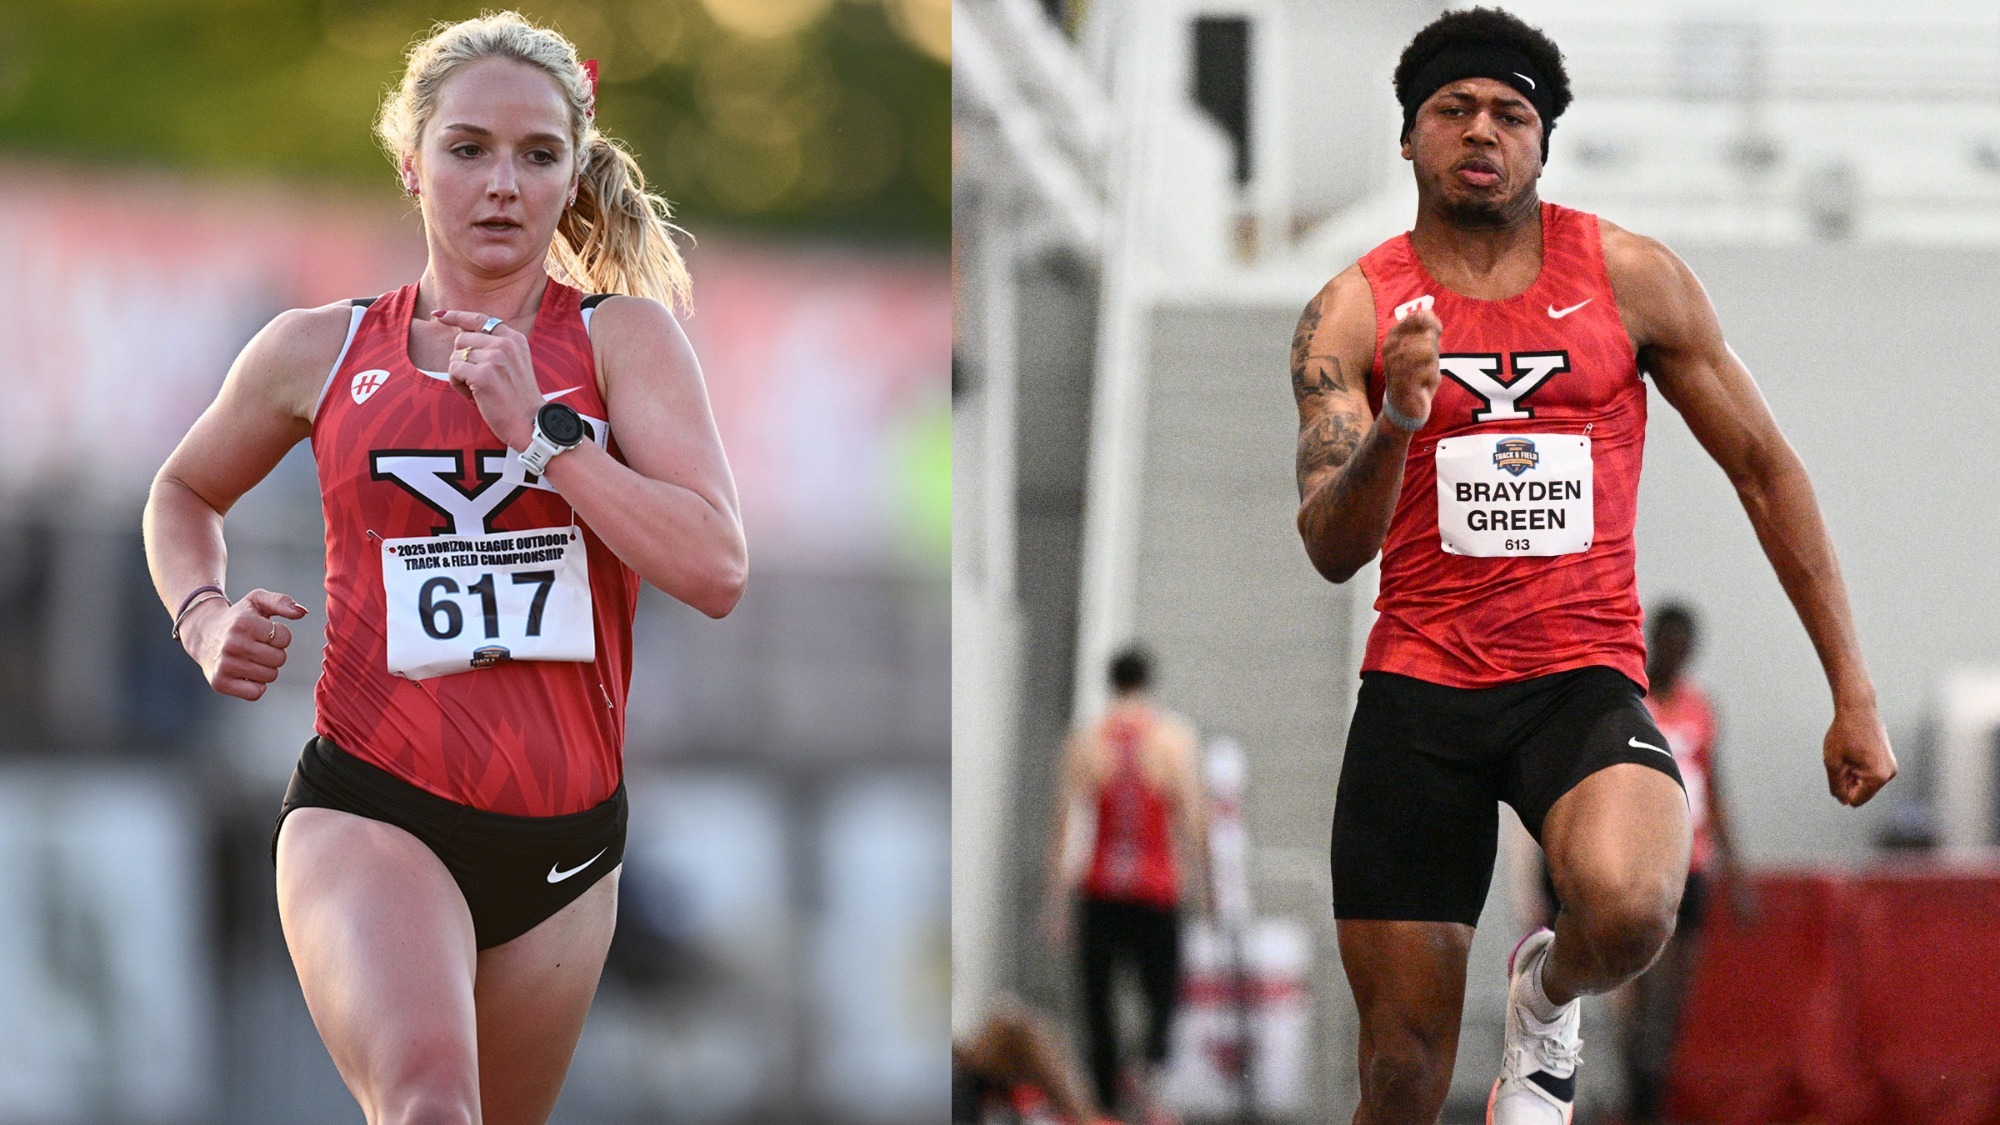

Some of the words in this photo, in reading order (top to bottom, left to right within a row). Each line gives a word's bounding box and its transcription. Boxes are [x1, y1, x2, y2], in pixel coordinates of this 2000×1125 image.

[1440, 351, 1571, 422] Y
[1495, 452, 1514, 460] TRACK
[1521, 452, 1538, 460] FIELD
[369, 449, 528, 536] Y
[1456, 480, 1581, 502] BRAYDEN
[1467, 508, 1566, 531] GREEN
[397, 544, 425, 556] 2025
[427, 541, 473, 554] HORIZON
[475, 539, 515, 552] LEAGUE
[518, 534, 568, 549] OUTDOOR
[1504, 539, 1531, 551] 613
[405, 556, 441, 571] TRACK
[442, 557, 451, 567] &
[451, 554, 478, 567] FIELD
[481, 548, 564, 566] CHAMPIONSHIP
[418, 570, 555, 640] 617
